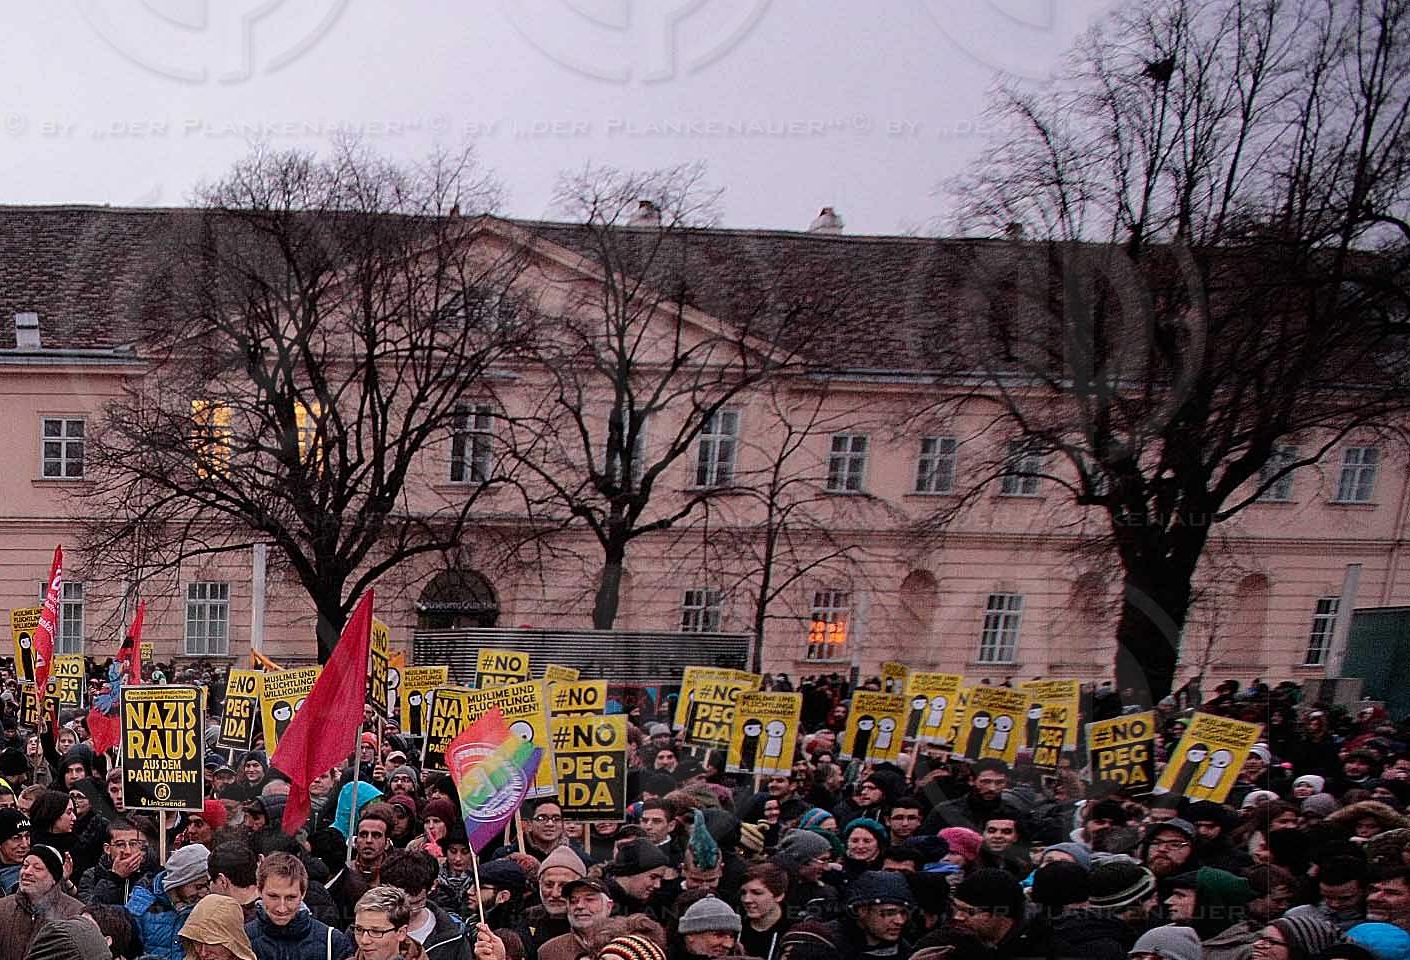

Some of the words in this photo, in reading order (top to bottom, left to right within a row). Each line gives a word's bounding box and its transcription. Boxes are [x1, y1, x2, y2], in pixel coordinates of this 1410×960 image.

[482, 655, 522, 672] #NO
[61, 678, 79, 691] EG
[229, 676, 256, 693] #NO
[263, 672, 297, 684] MUSLIME
[298, 669, 317, 680] UND
[263, 676, 318, 691] FLÜCHTLINGE
[25, 684, 57, 693] #O
[467, 688, 510, 704] MUSLIME
[512, 684, 535, 698] UND
[555, 687, 599, 706] #NO
[25, 695, 55, 712] PG
[226, 698, 251, 718] PEG
[468, 694, 537, 713] FLÜCHTLINGE
[125, 701, 197, 730] NAZIS
[223, 717, 247, 739] IDA
[552, 723, 617, 749] #NO
[126, 729, 198, 761] RAUS
[142, 760, 161, 770] AUS
[162, 760, 181, 770] DEM
[1098, 744, 1149, 769] PEG
[127, 769, 198, 784] PARLAMENT
[557, 755, 616, 780] PEG
[147, 799, 187, 808] Linkswende
[559, 782, 615, 806] IDA
